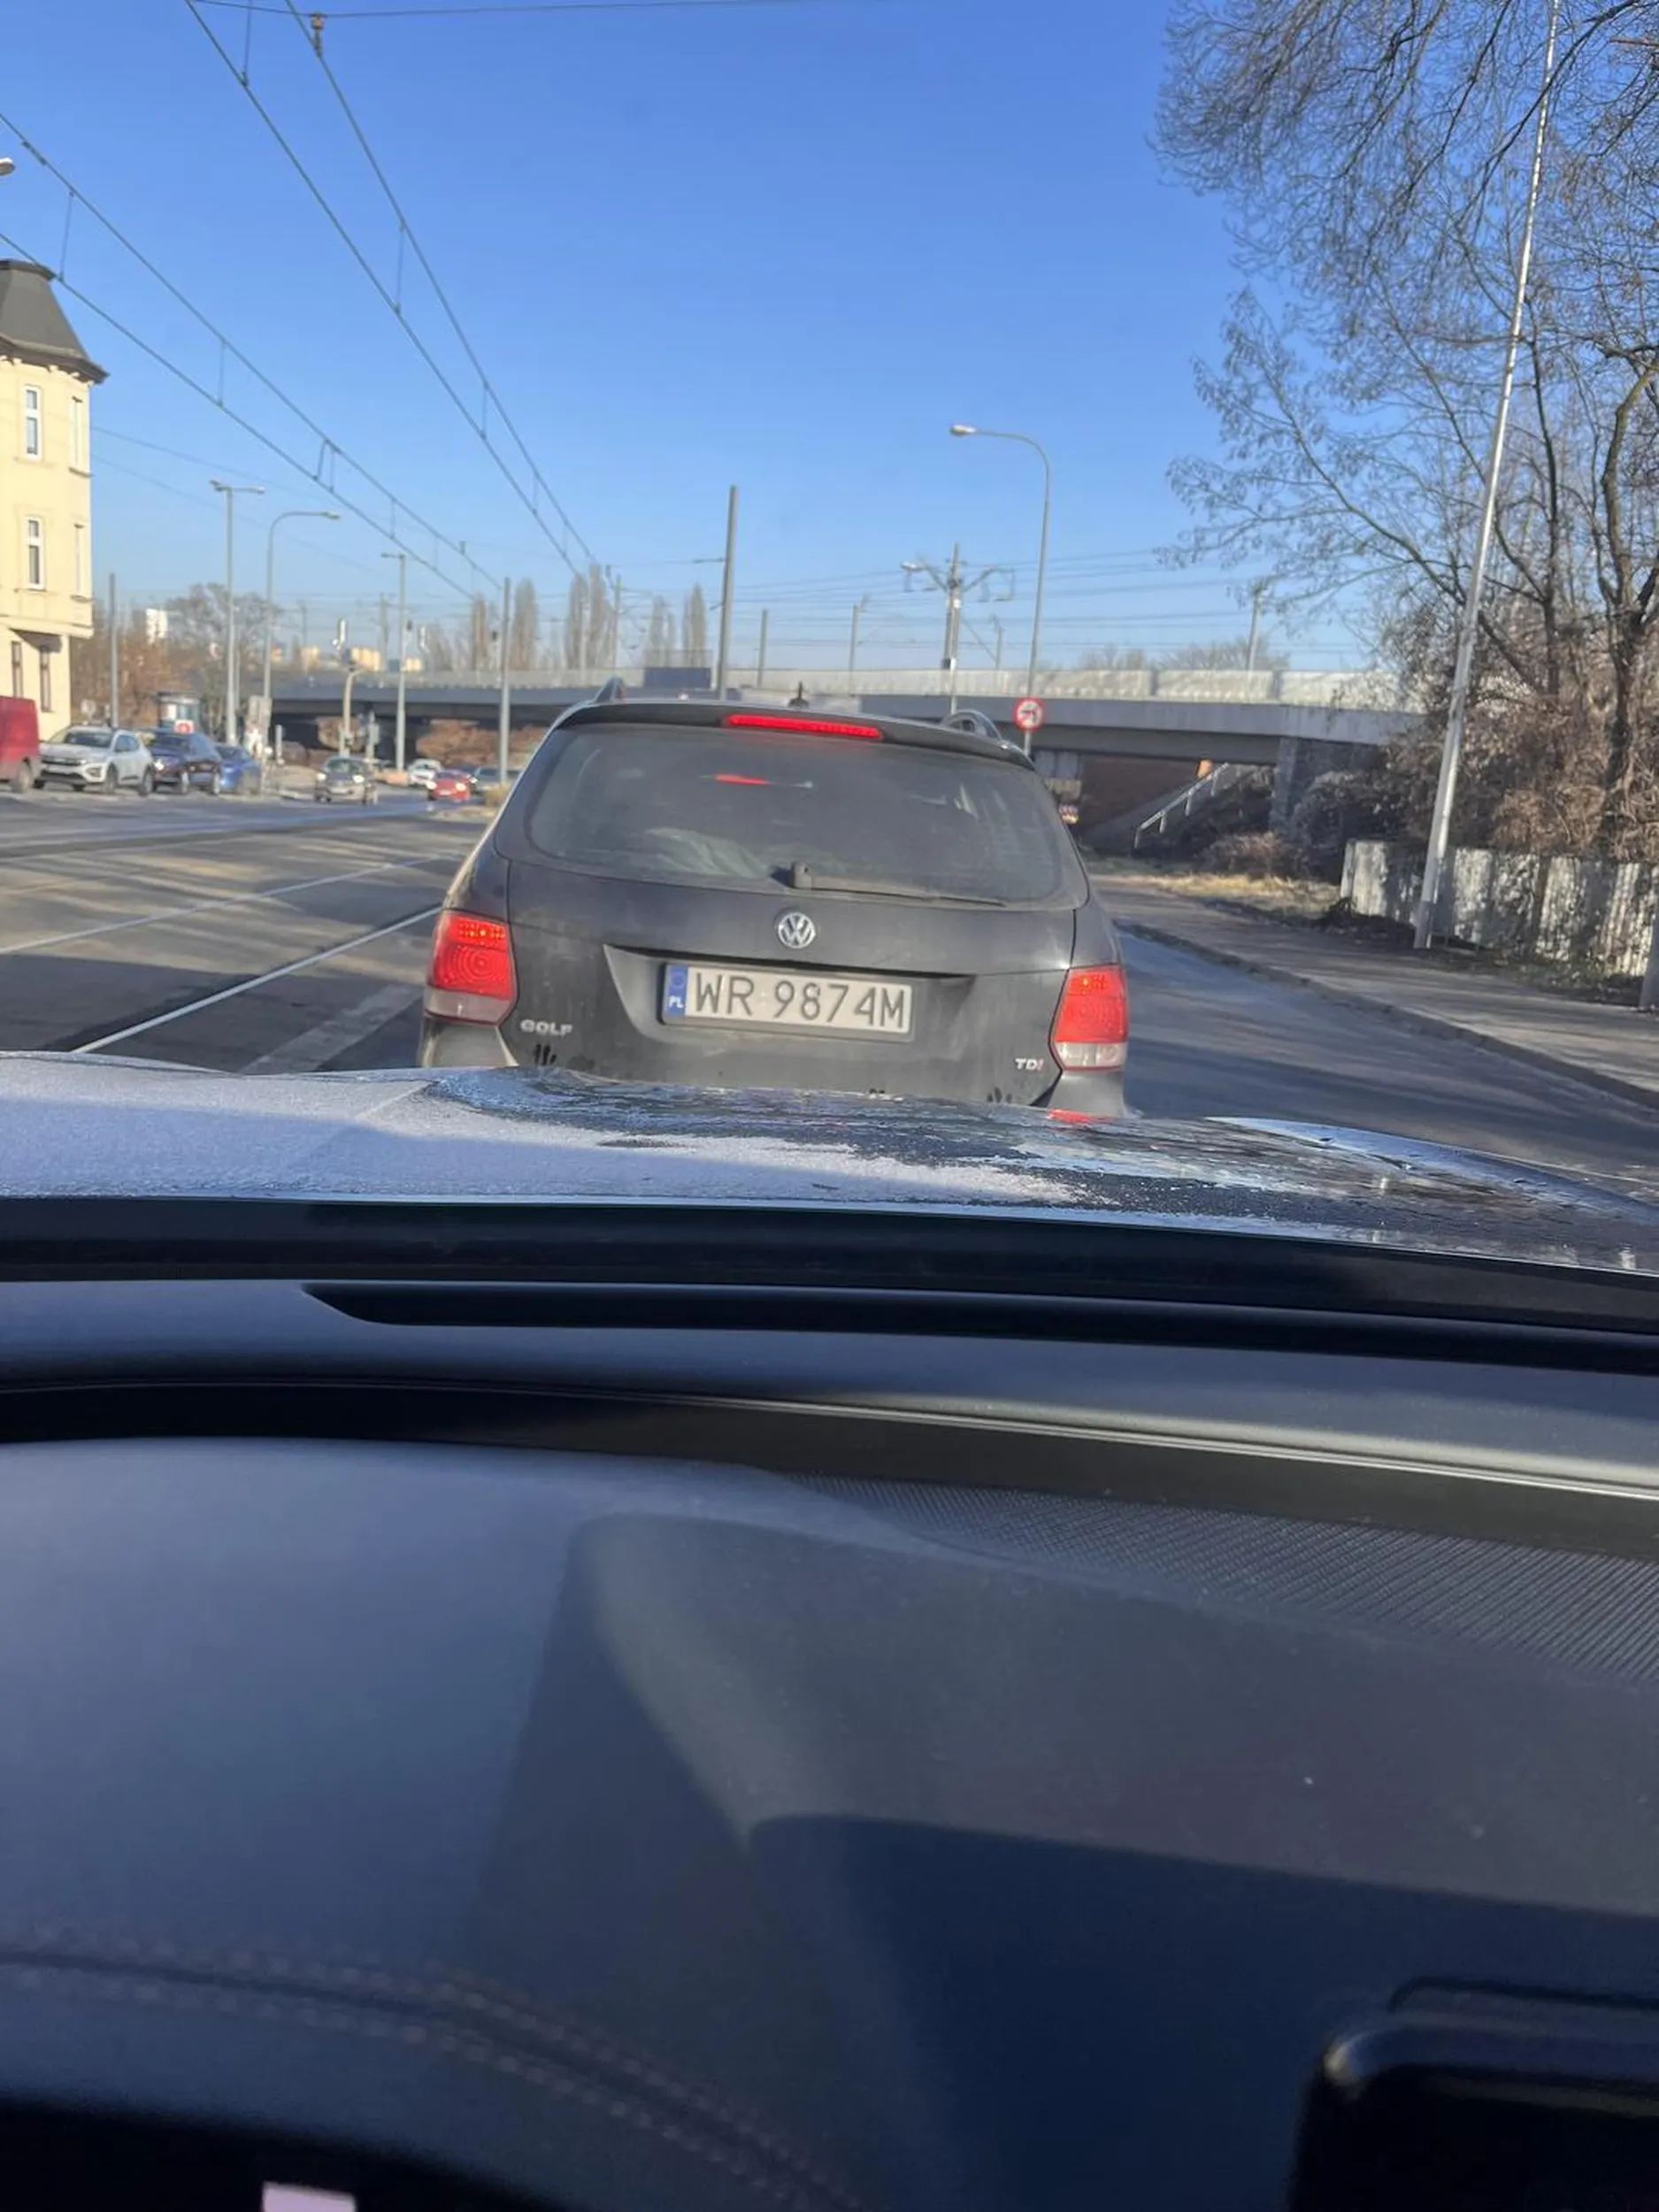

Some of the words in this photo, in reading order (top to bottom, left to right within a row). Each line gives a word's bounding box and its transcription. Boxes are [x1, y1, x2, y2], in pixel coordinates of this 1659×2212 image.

[778, 912, 815, 949] VW
[669, 995, 684, 1008] PL
[695, 972, 754, 1016] WR
[773, 980, 904, 1027] 9874M
[520, 1019, 573, 1036] GOLF
[1015, 1058, 1045, 1071] TDI
